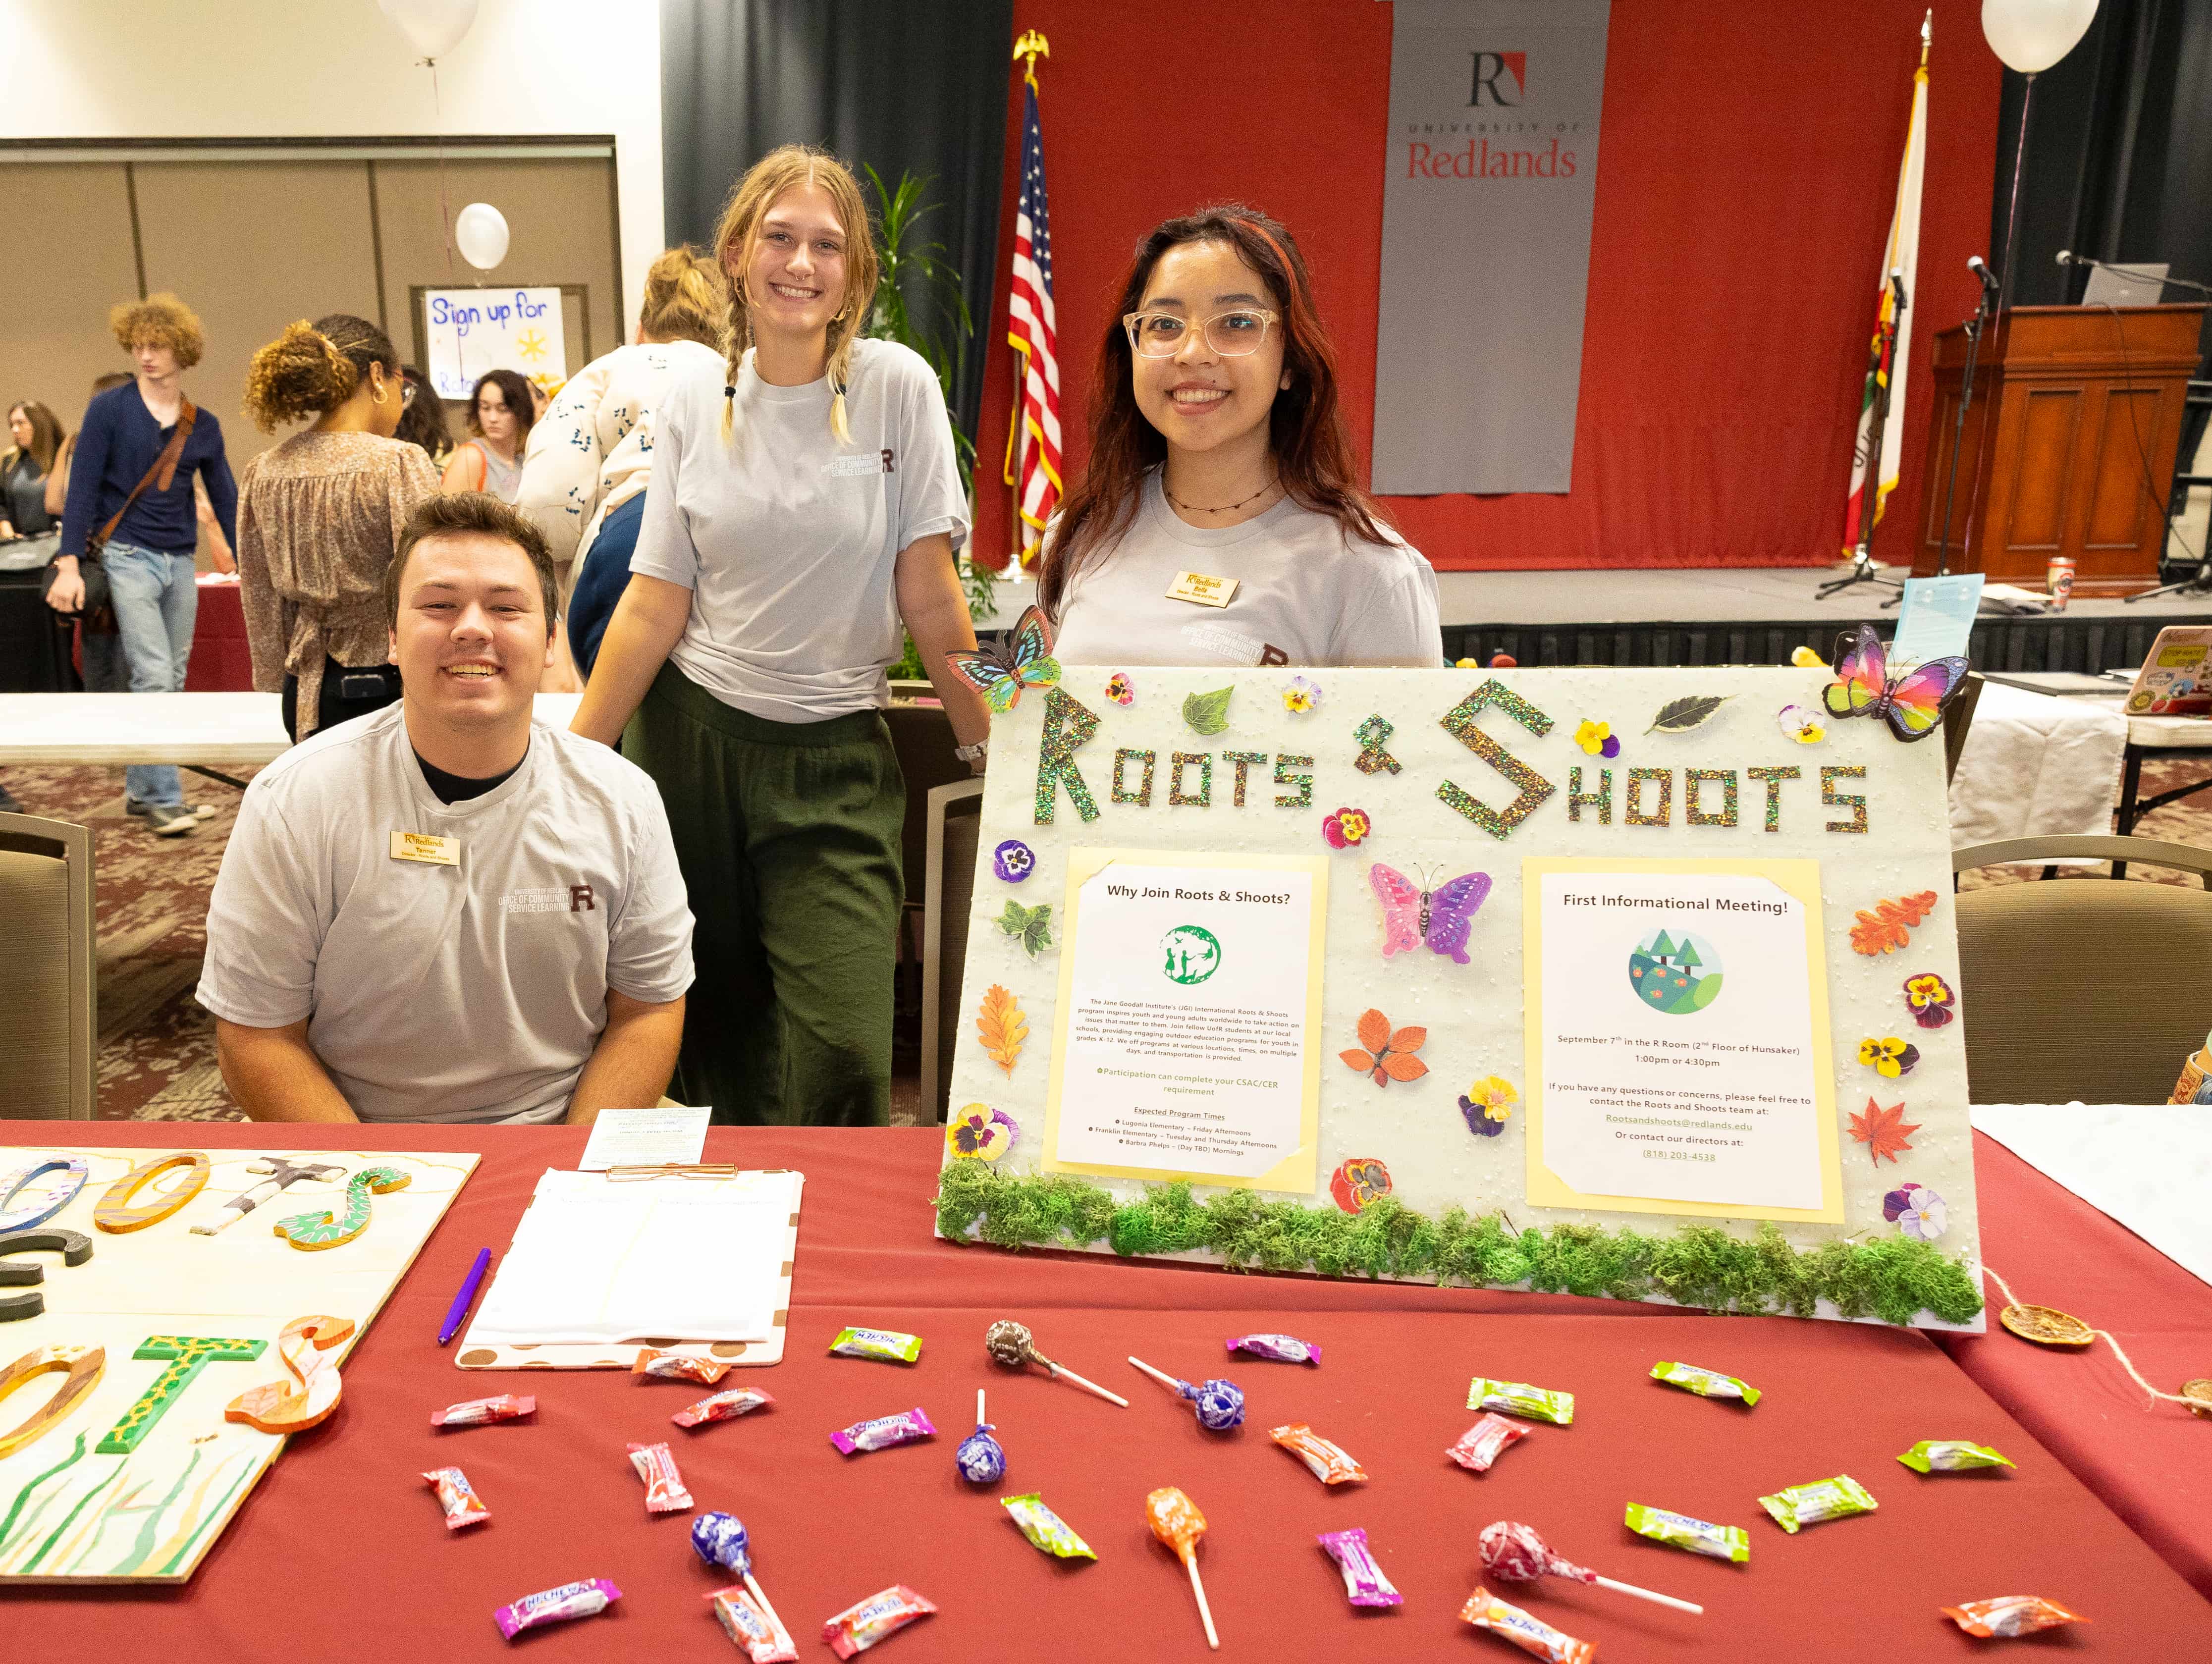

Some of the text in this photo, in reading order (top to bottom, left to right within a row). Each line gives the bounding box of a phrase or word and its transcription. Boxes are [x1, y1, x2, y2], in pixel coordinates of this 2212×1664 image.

[1466, 52, 1516, 107] R
[1408, 123, 1579, 133] UNIVERSITY OF
[1407, 138, 1576, 179] Redlands
[432, 292, 547, 336] Sign up for
[1195, 578, 1221, 589] Redlands
[1352, 712, 1404, 775] &
[416, 838, 444, 847] Redlands
[519, 895, 527, 904] OF
[529, 894, 569, 903] COMMUNITY
[570, 884, 595, 912] R
[1107, 885, 1291, 904] Why Join Roots & Shoots?
[508, 902, 569, 913] SERVICE LEARNING
[1564, 894, 1788, 915] First Informational Meeting!
[1558, 1035, 1608, 1044] September
[1751, 1045, 1800, 1055] Hunsaker)
[1635, 1055, 1670, 1065] 1:00pm
[1684, 1058, 1720, 1068] 4:30pm
[1103, 1068, 1156, 1078] Participation
[1236, 1078, 1278, 1088] CSAC/CER
[1163, 1086, 1214, 1095] requirement
[1619, 1087, 1665, 1096] questions
[1725, 1093, 1756, 1101] please
[1779, 1095, 1798, 1104] free
[1133, 1107, 1225, 1121] Expected Program Times
[1694, 1104, 1727, 1112] Shoots
[1149, 1123, 1185, 1131] Elementary
[1606, 1114, 1752, 1130] Rootsandshoots@redlands.edu
[1122, 1129, 1158, 1139] Elementary
[1165, 1133, 1192, 1142] Tuesday
[1208, 1137, 1239, 1146] Thursday
[1685, 1136, 1728, 1145] directors
[1212, 1147, 1244, 1156] Mornings
[1643, 1150, 1716, 1161] (818) 203-4538
